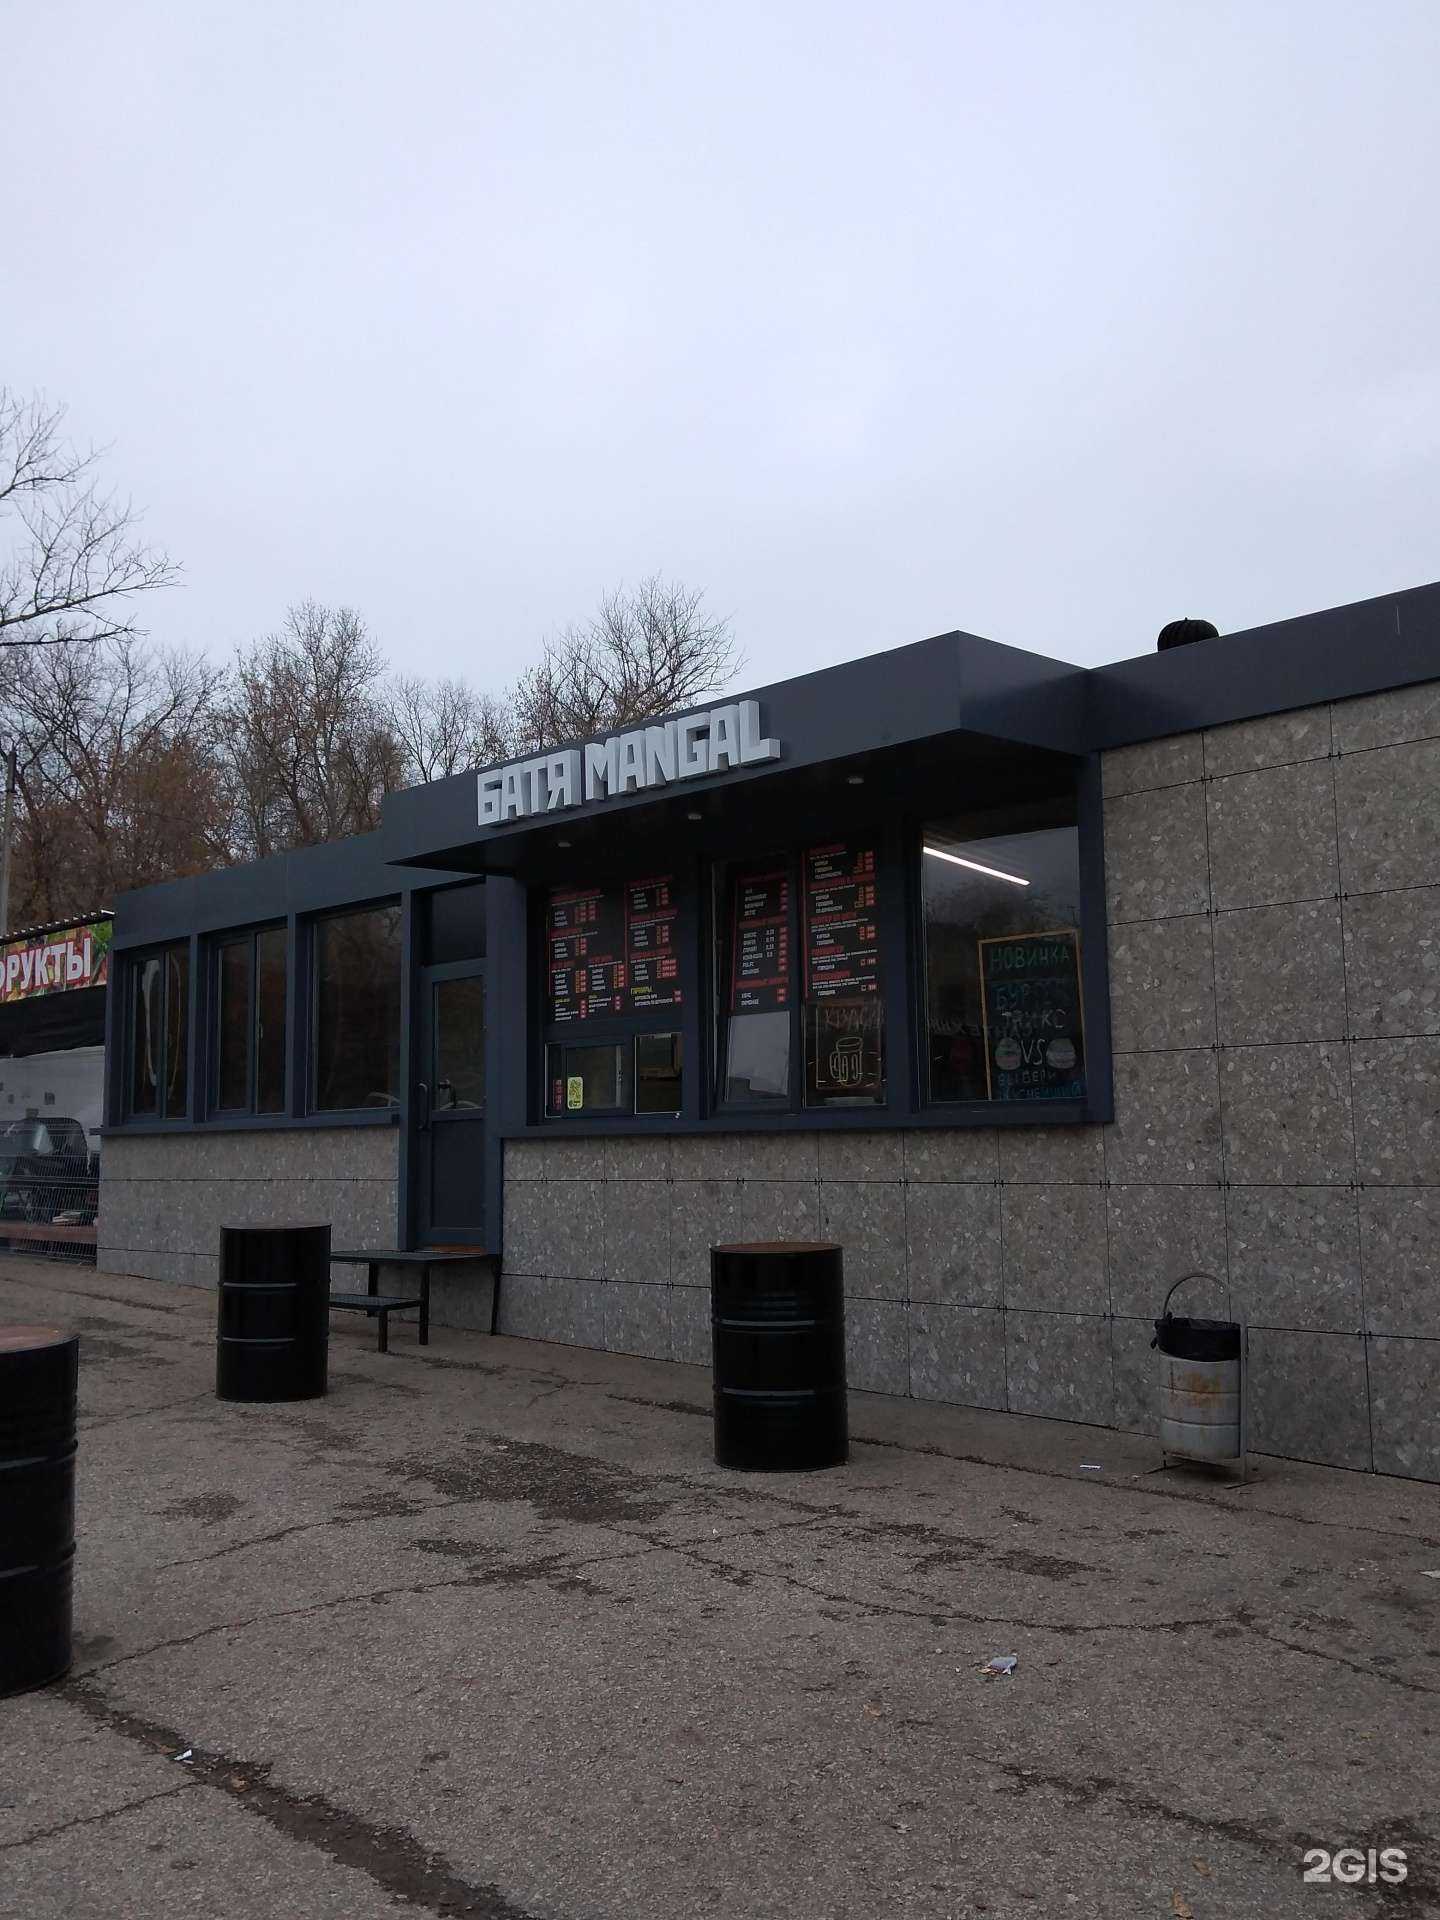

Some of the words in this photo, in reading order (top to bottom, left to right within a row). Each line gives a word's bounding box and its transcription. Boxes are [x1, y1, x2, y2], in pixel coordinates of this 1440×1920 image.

[477, 749, 583, 826] БАТЯ
[585, 699, 781, 800] MANGAL
[991, 944, 1070, 970] НОВИНКА
[1019, 1038, 1046, 1066] VS
